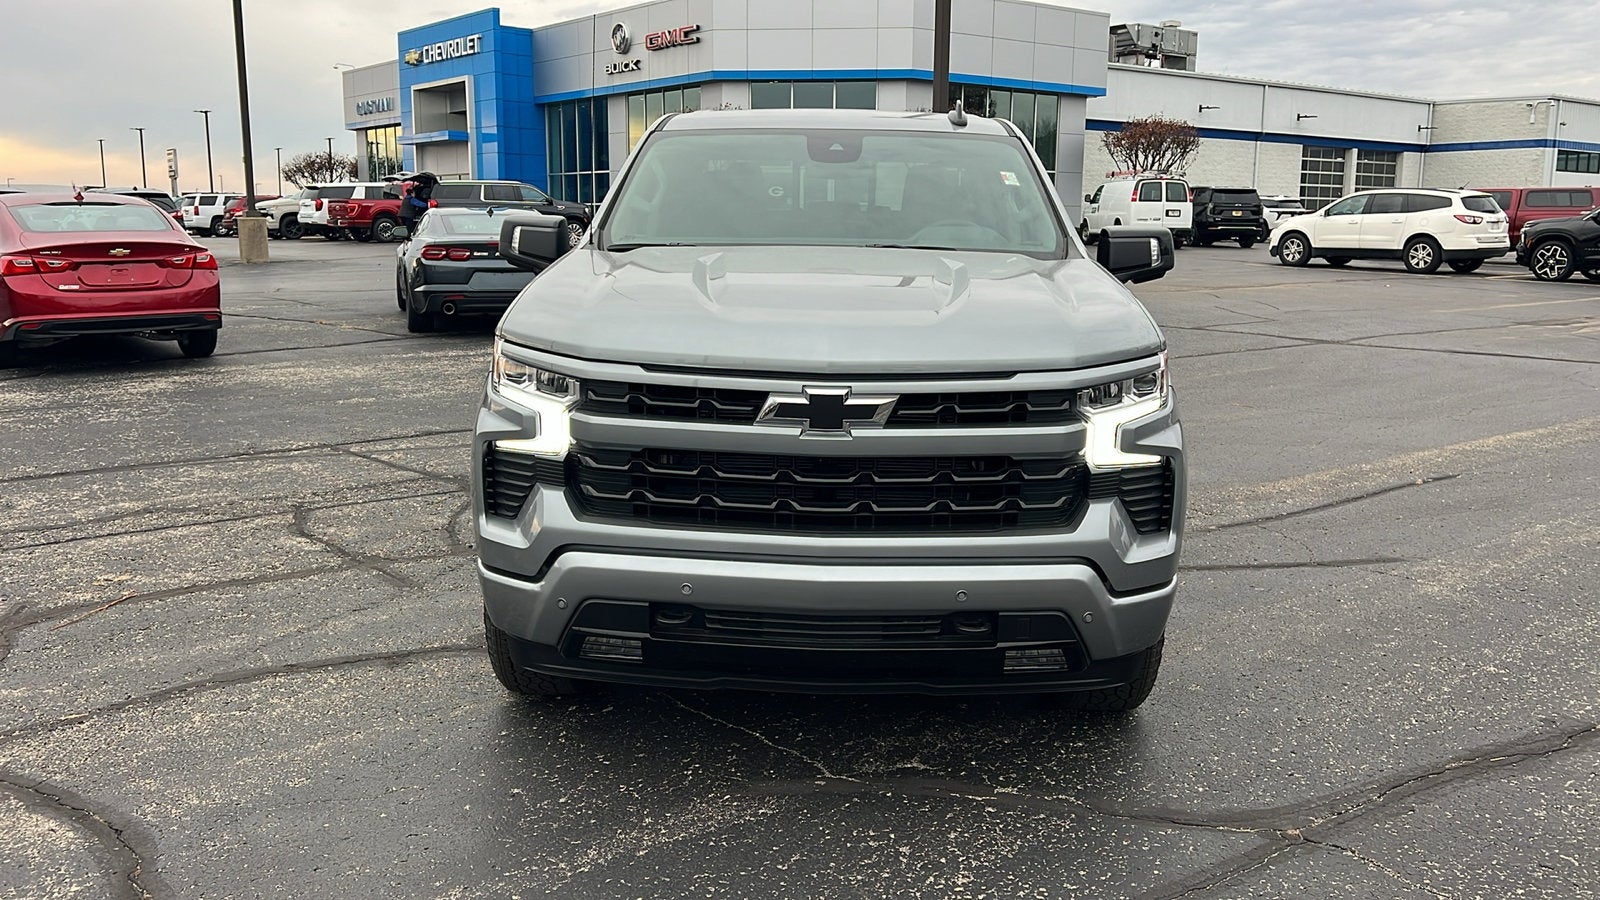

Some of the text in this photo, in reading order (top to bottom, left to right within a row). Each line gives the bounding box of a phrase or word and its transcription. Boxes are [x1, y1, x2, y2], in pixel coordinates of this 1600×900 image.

[423, 34, 480, 64] CHEVROLET
[645, 24, 700, 51] GMC
[605, 59, 640, 75] BUICK
